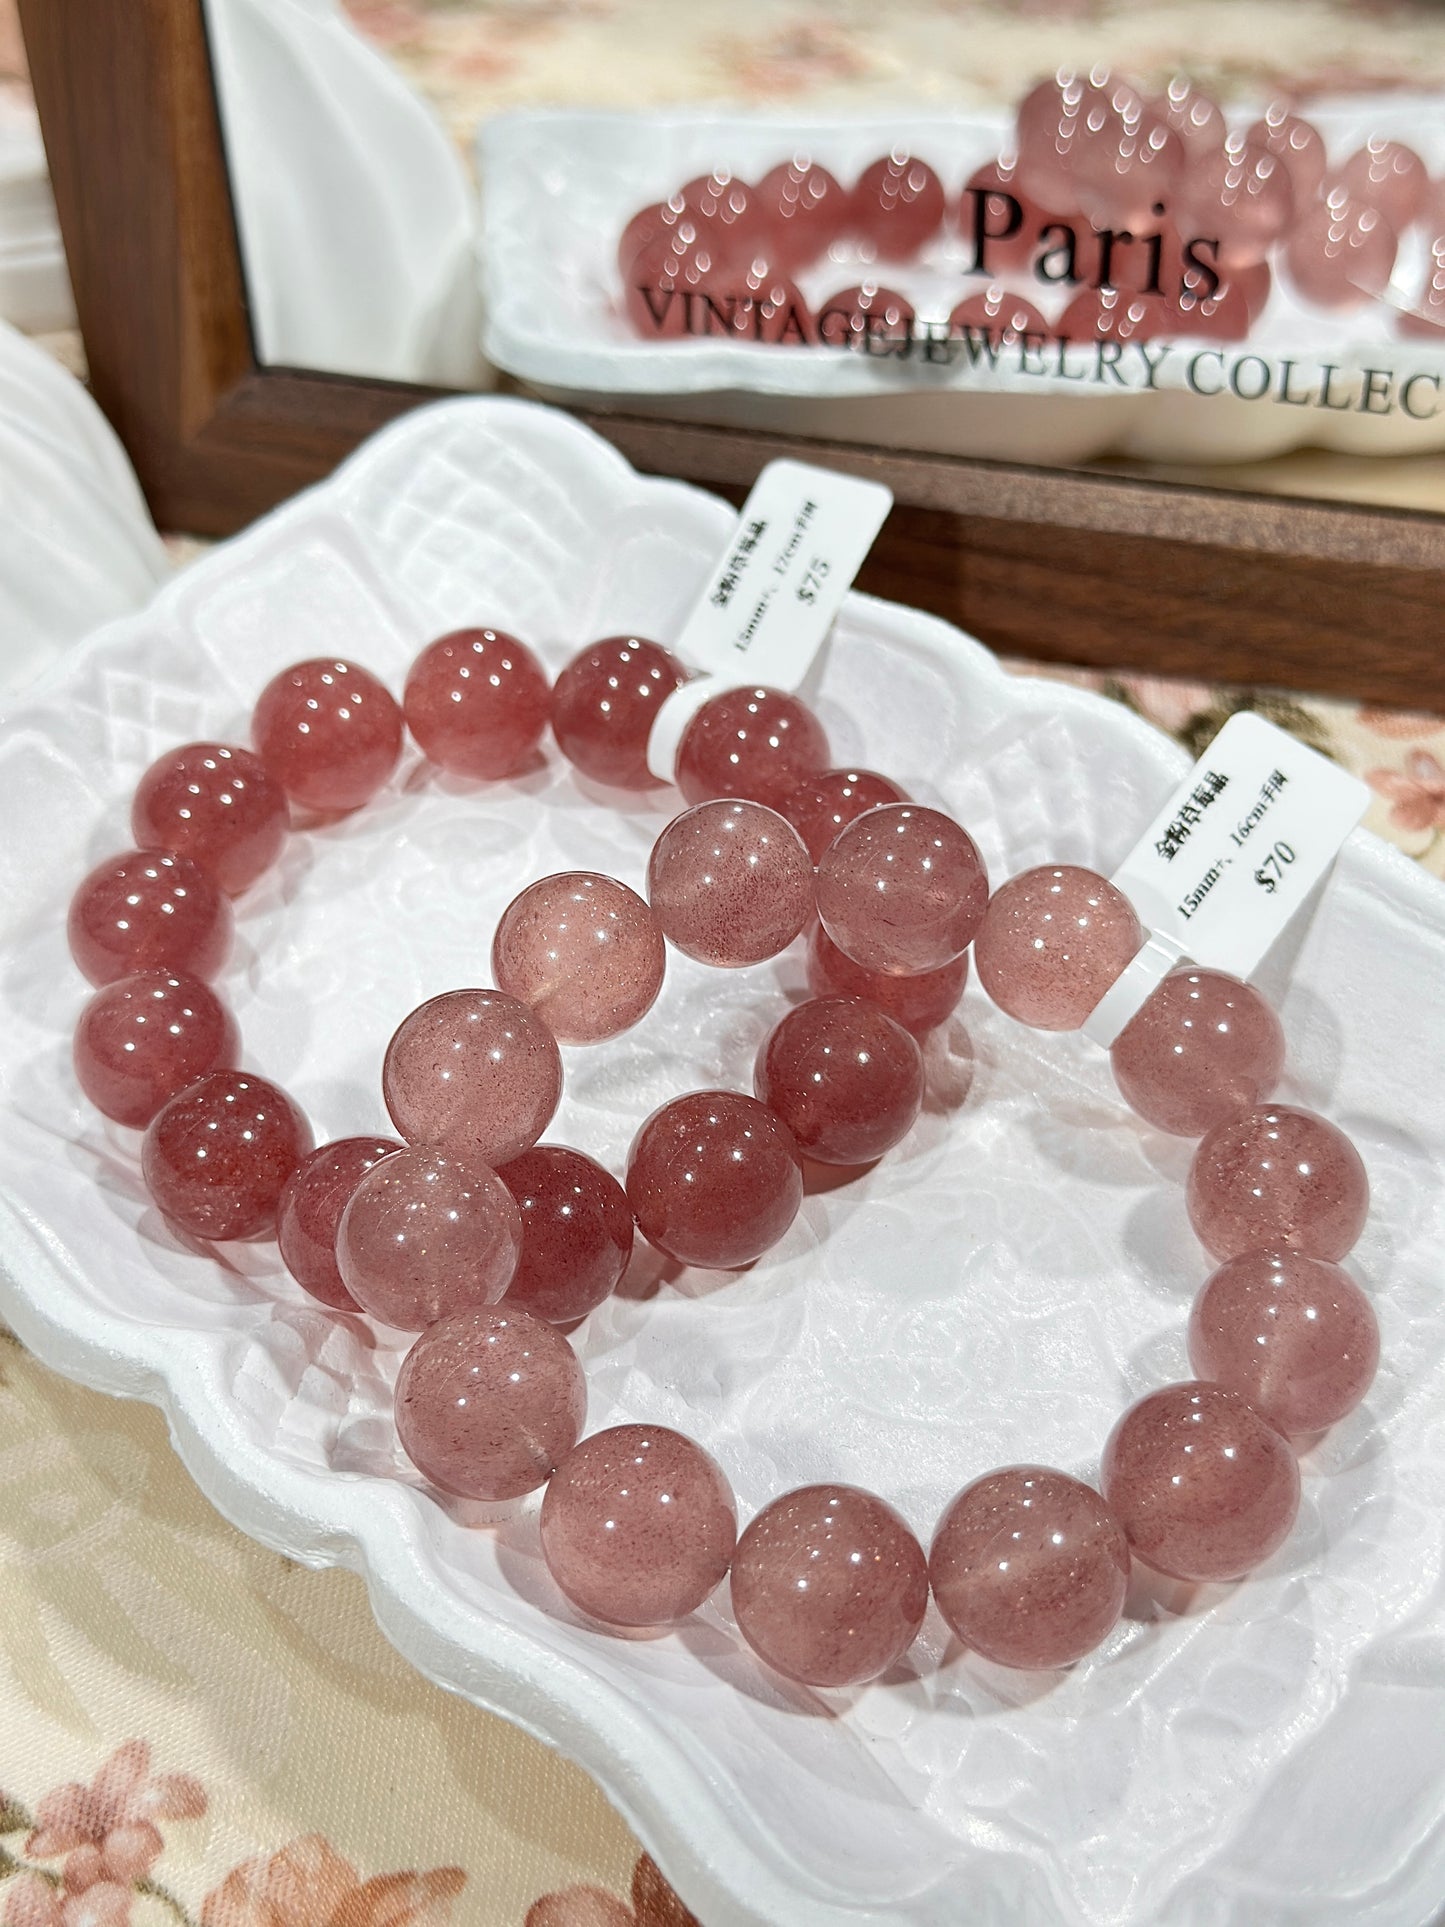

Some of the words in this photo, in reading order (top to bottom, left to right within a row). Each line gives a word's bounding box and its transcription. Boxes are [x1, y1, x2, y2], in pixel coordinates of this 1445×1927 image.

[962, 187, 1220, 300] Paris
[796, 556, 831, 606] $75
[1154, 770, 1230, 863] 金粉草莓晶
[1254, 840, 1296, 894] $70
